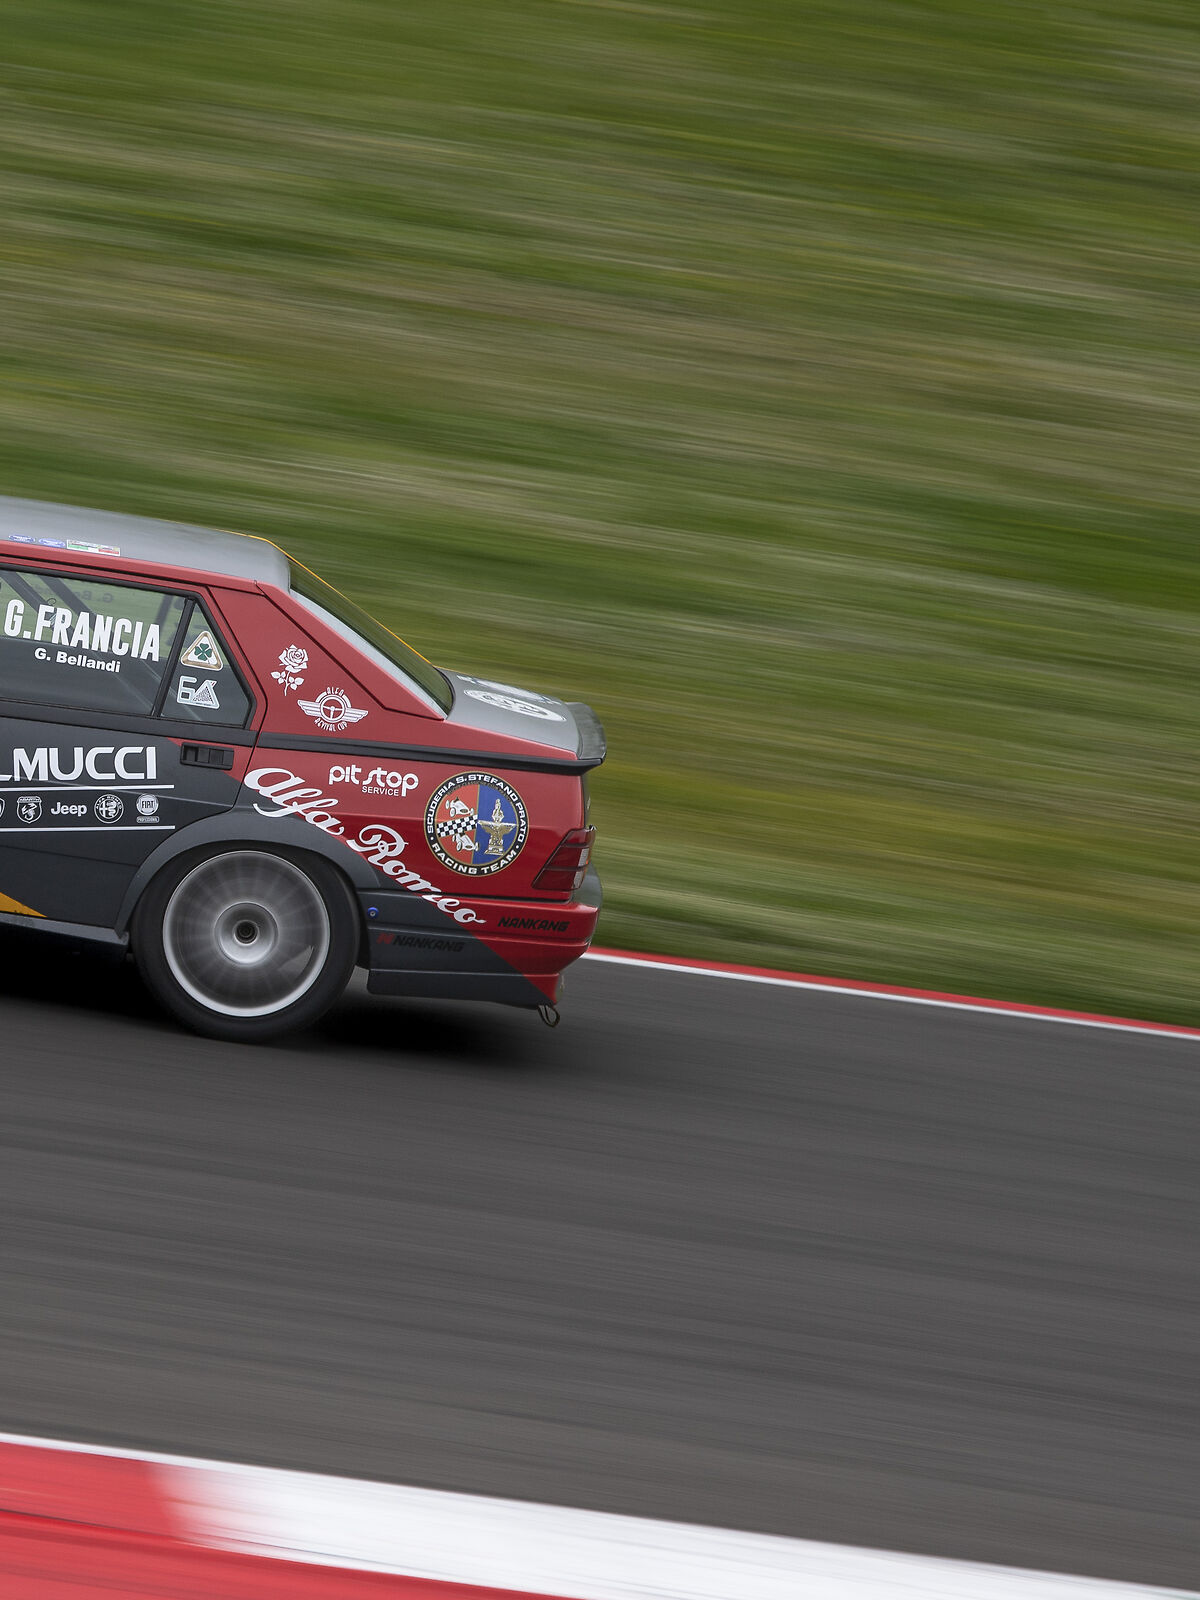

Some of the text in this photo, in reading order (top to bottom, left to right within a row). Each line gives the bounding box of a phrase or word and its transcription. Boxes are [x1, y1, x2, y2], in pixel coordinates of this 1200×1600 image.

[4, 599, 160, 662] G.FRANCIA
[34, 647, 121, 673] G. Bellandi
[327, 686, 345, 697] ALFA
[314, 717, 348, 732] REVIVAL CUP
[328, 764, 362, 785] pit
[362, 767, 419, 797] stop
[362, 785, 400, 797] SERVICE
[50, 801, 88, 817] Jeep
[141, 800, 155, 809] FIAT
[427, 783, 456, 834] SCUDERIA
[515, 801, 528, 843] PRATO
[244, 767, 487, 924] Alfa Romeo
[432, 842, 517, 875] RACING TEAM
[497, 916, 571, 933] NANKANG
[393, 935, 466, 953] NANKANG
